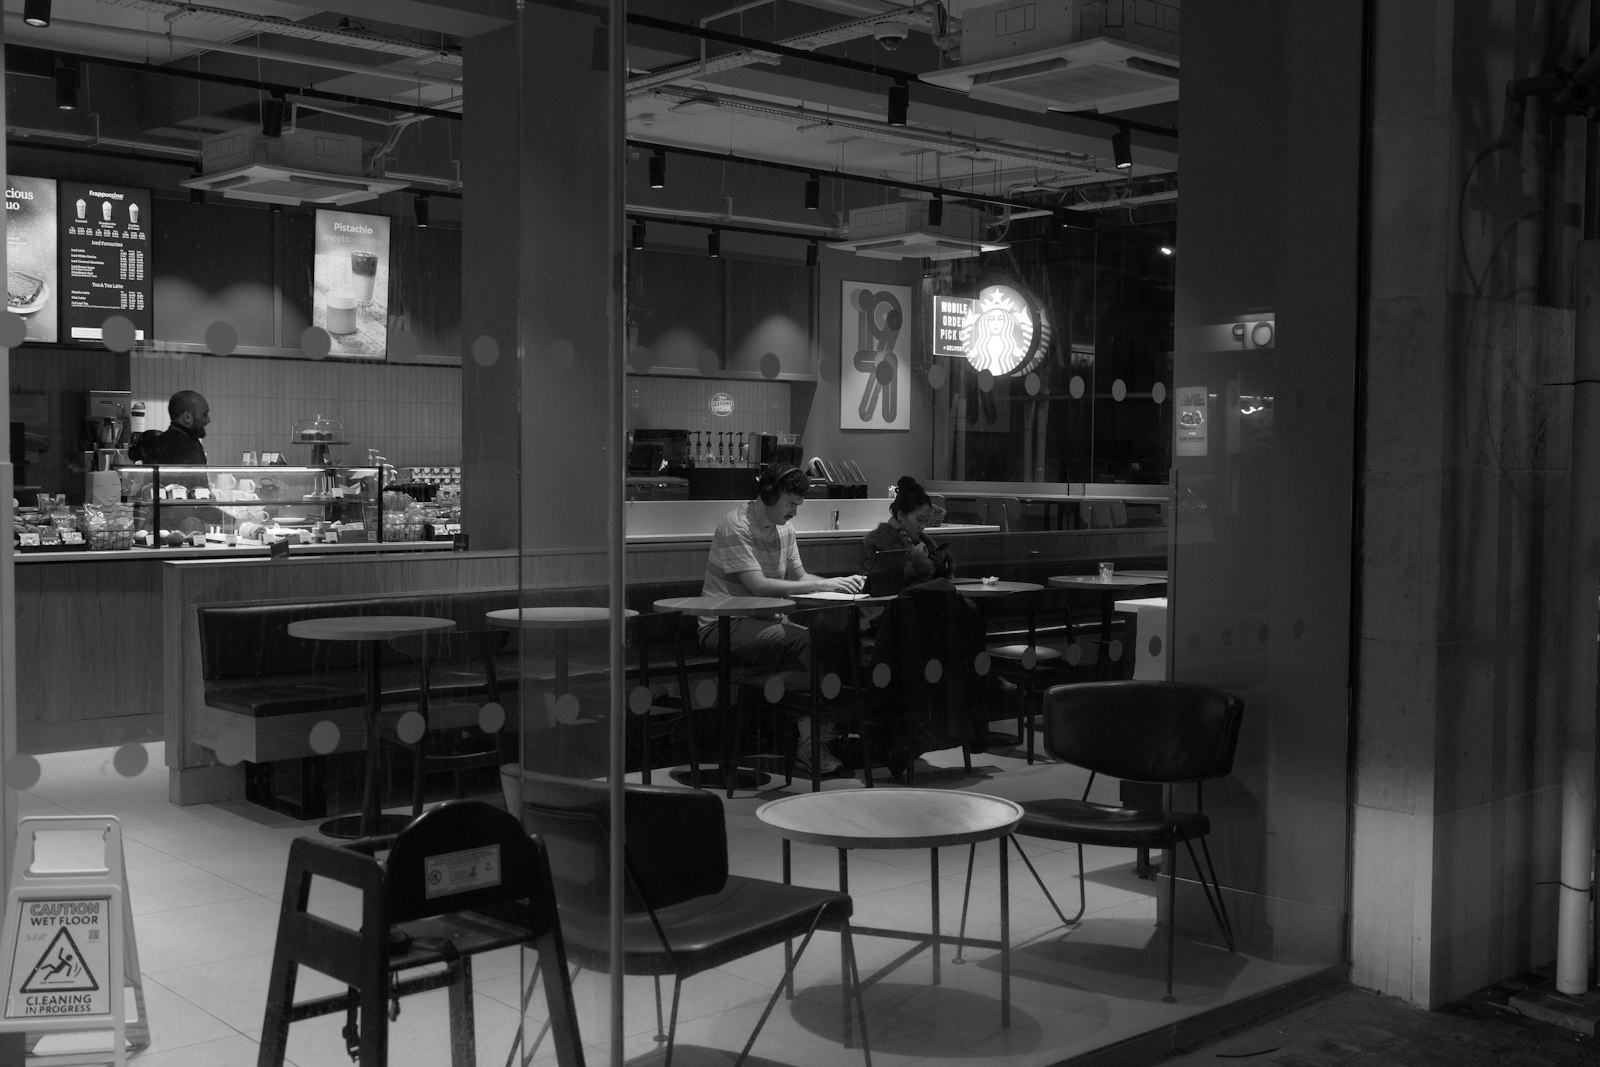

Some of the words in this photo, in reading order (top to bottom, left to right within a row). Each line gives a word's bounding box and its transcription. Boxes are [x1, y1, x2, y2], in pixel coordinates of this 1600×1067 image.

[88, 190, 123, 199] Frappuccino
[334, 222, 373, 234] Pistachio
[323, 234, 349, 242] meets
[941, 302, 967, 314] MOBILE
[941, 329, 956, 340] PICK
[30, 902, 99, 916] CAUTION
[31, 916, 56, 926] WET
[59, 916, 98, 925] FLOOR
[26, 994, 92, 1006] CLEANING
[25, 1006, 36, 1014] IN
[39, 1004, 91, 1014] PROGRESS
